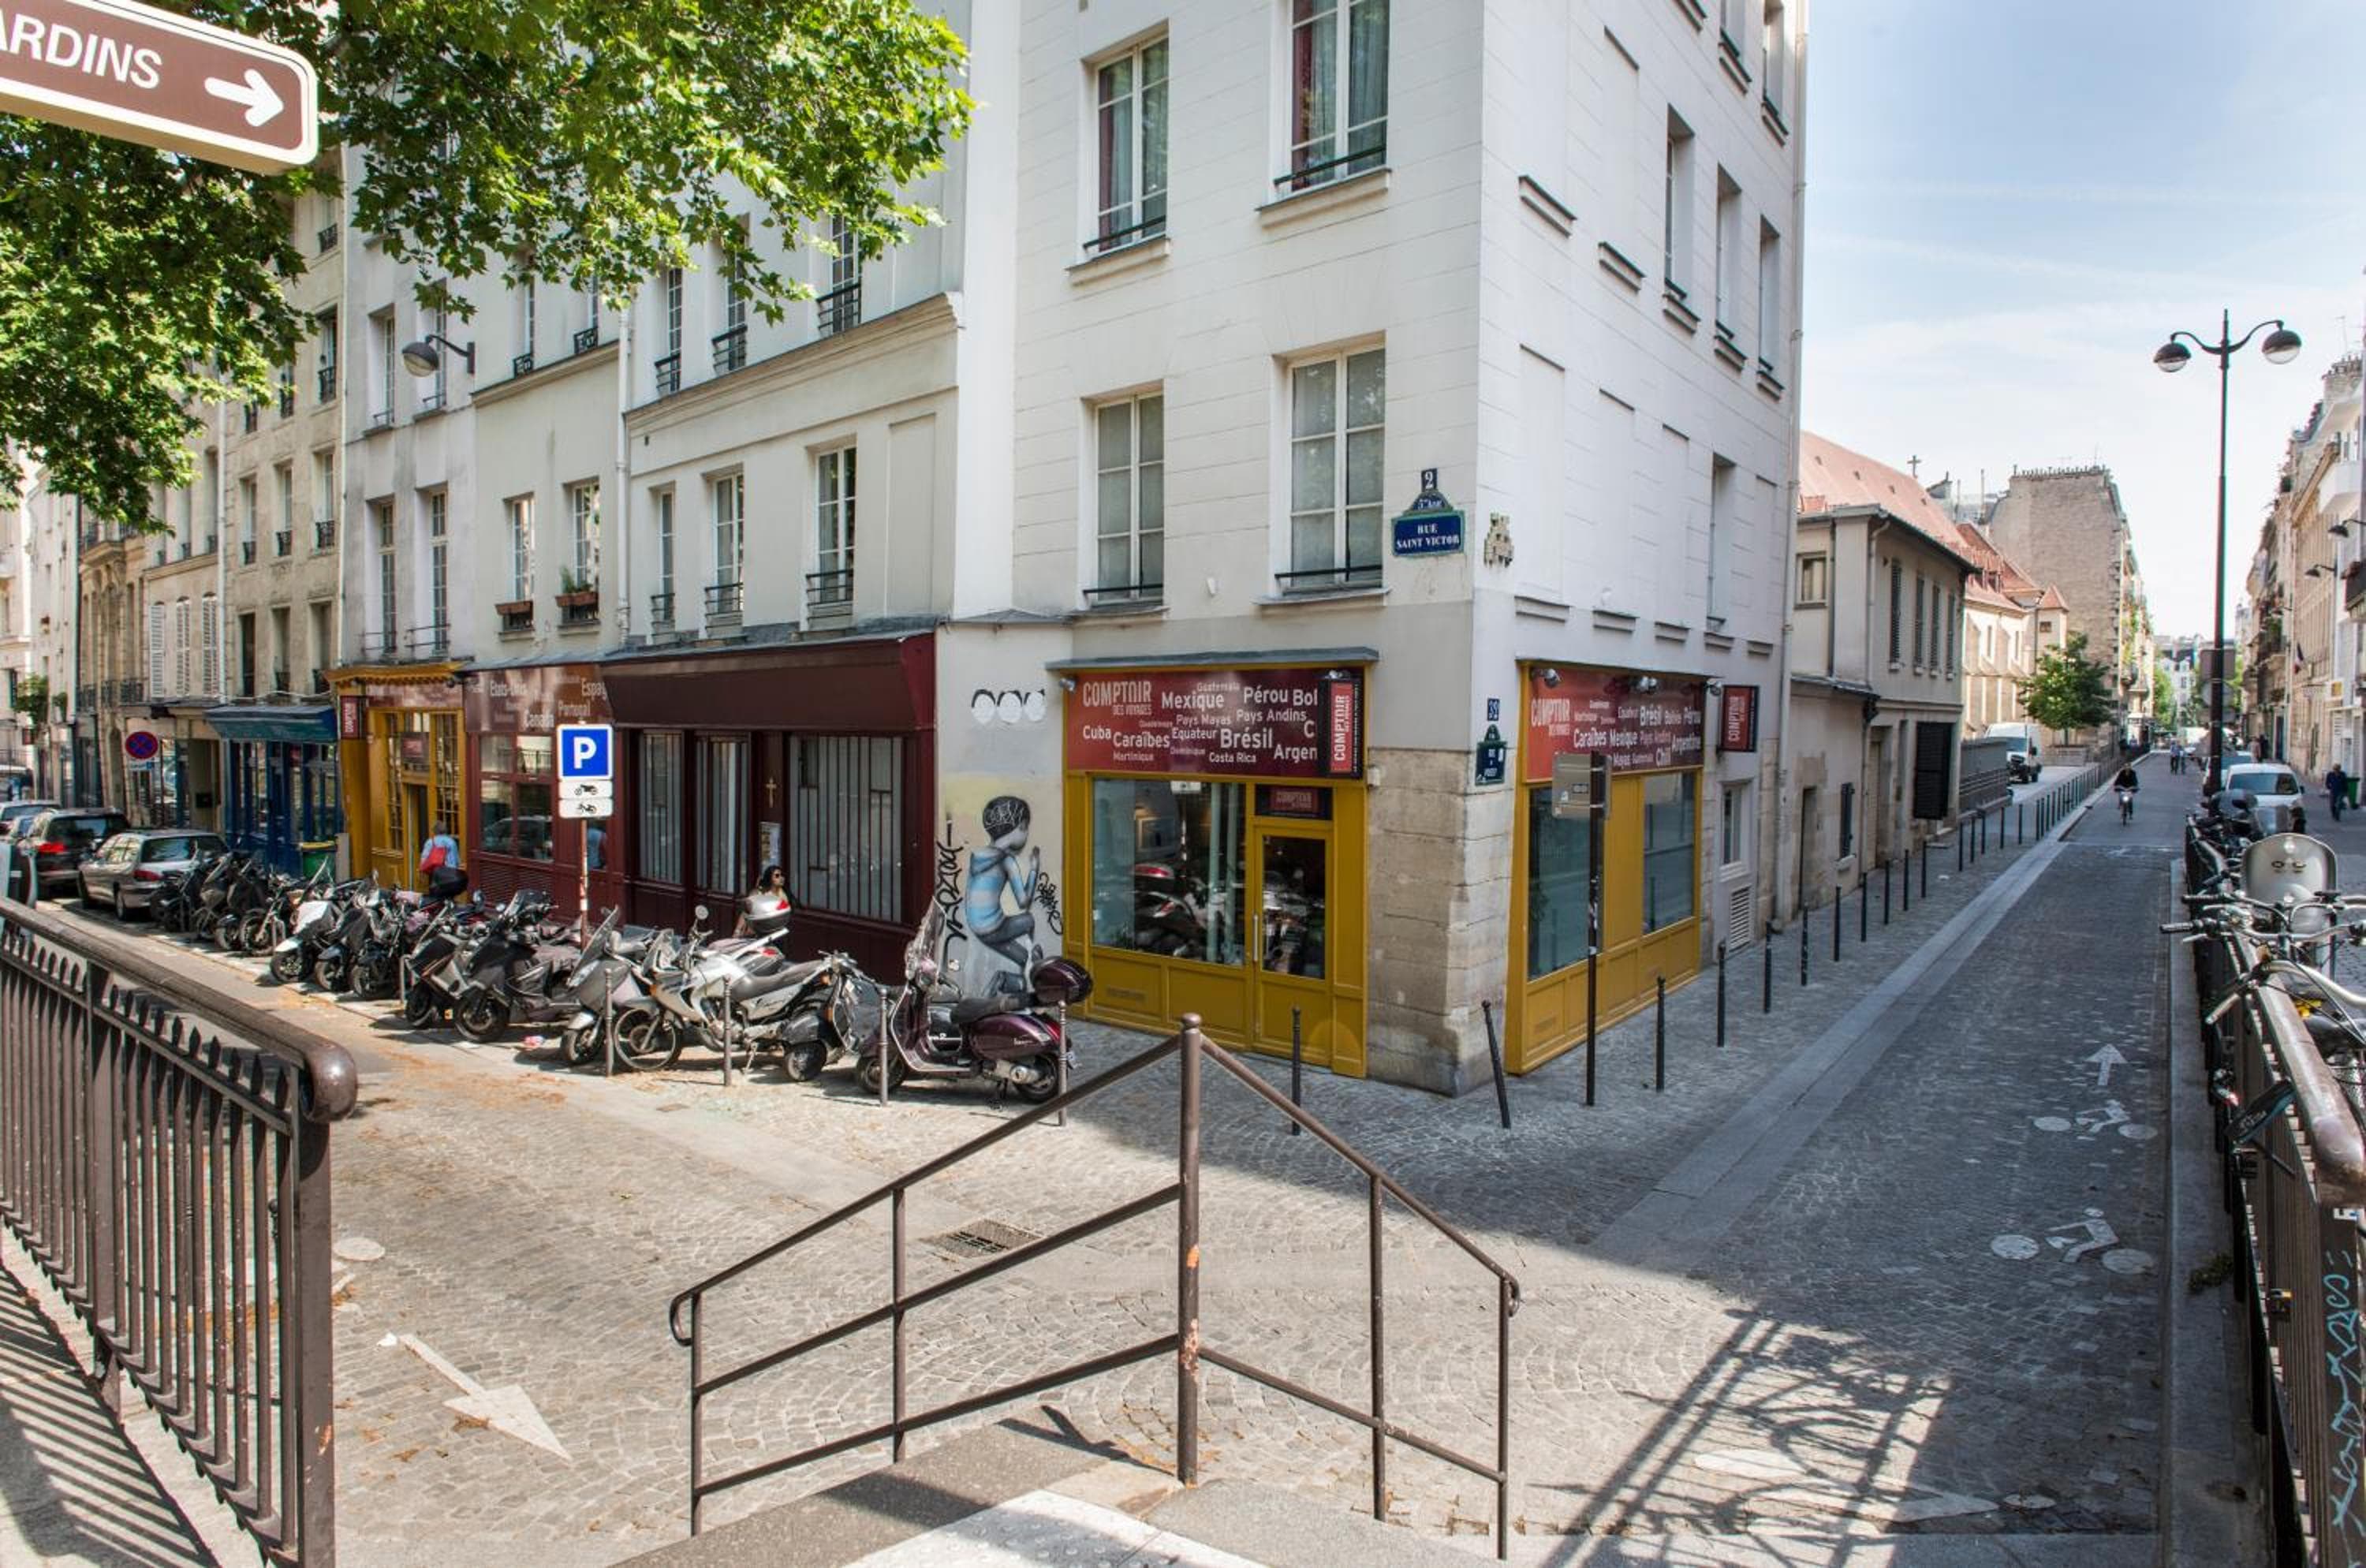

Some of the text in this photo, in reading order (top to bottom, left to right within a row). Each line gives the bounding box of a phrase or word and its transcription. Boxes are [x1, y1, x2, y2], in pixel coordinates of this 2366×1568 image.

[1425, 471, 1434, 489] 2
[1417, 523, 1438, 535] RUE
[1397, 534, 1460, 549] SAINT VICTOR
[1083, 681, 1151, 707] COMPTOIR
[1162, 691, 1225, 711] Mexique
[1244, 685, 1288, 704] Pérou
[1293, 689, 1318, 706] Bol
[1176, 714, 1232, 726] Pays Mayas
[1237, 709, 1307, 722] Pays Andins
[1640, 704, 1662, 726] Brésil
[1083, 725, 1111, 740] Cuba
[1171, 726, 1218, 741] Equateur
[1334, 695, 1346, 761] COMPTOIR
[1113, 731, 1170, 748] Caraïbes
[1220, 726, 1273, 749] Brésil
[573, 736, 597, 769] P
[1209, 752, 1256, 763] Costa Rica
[1274, 744, 1318, 763] Argen
